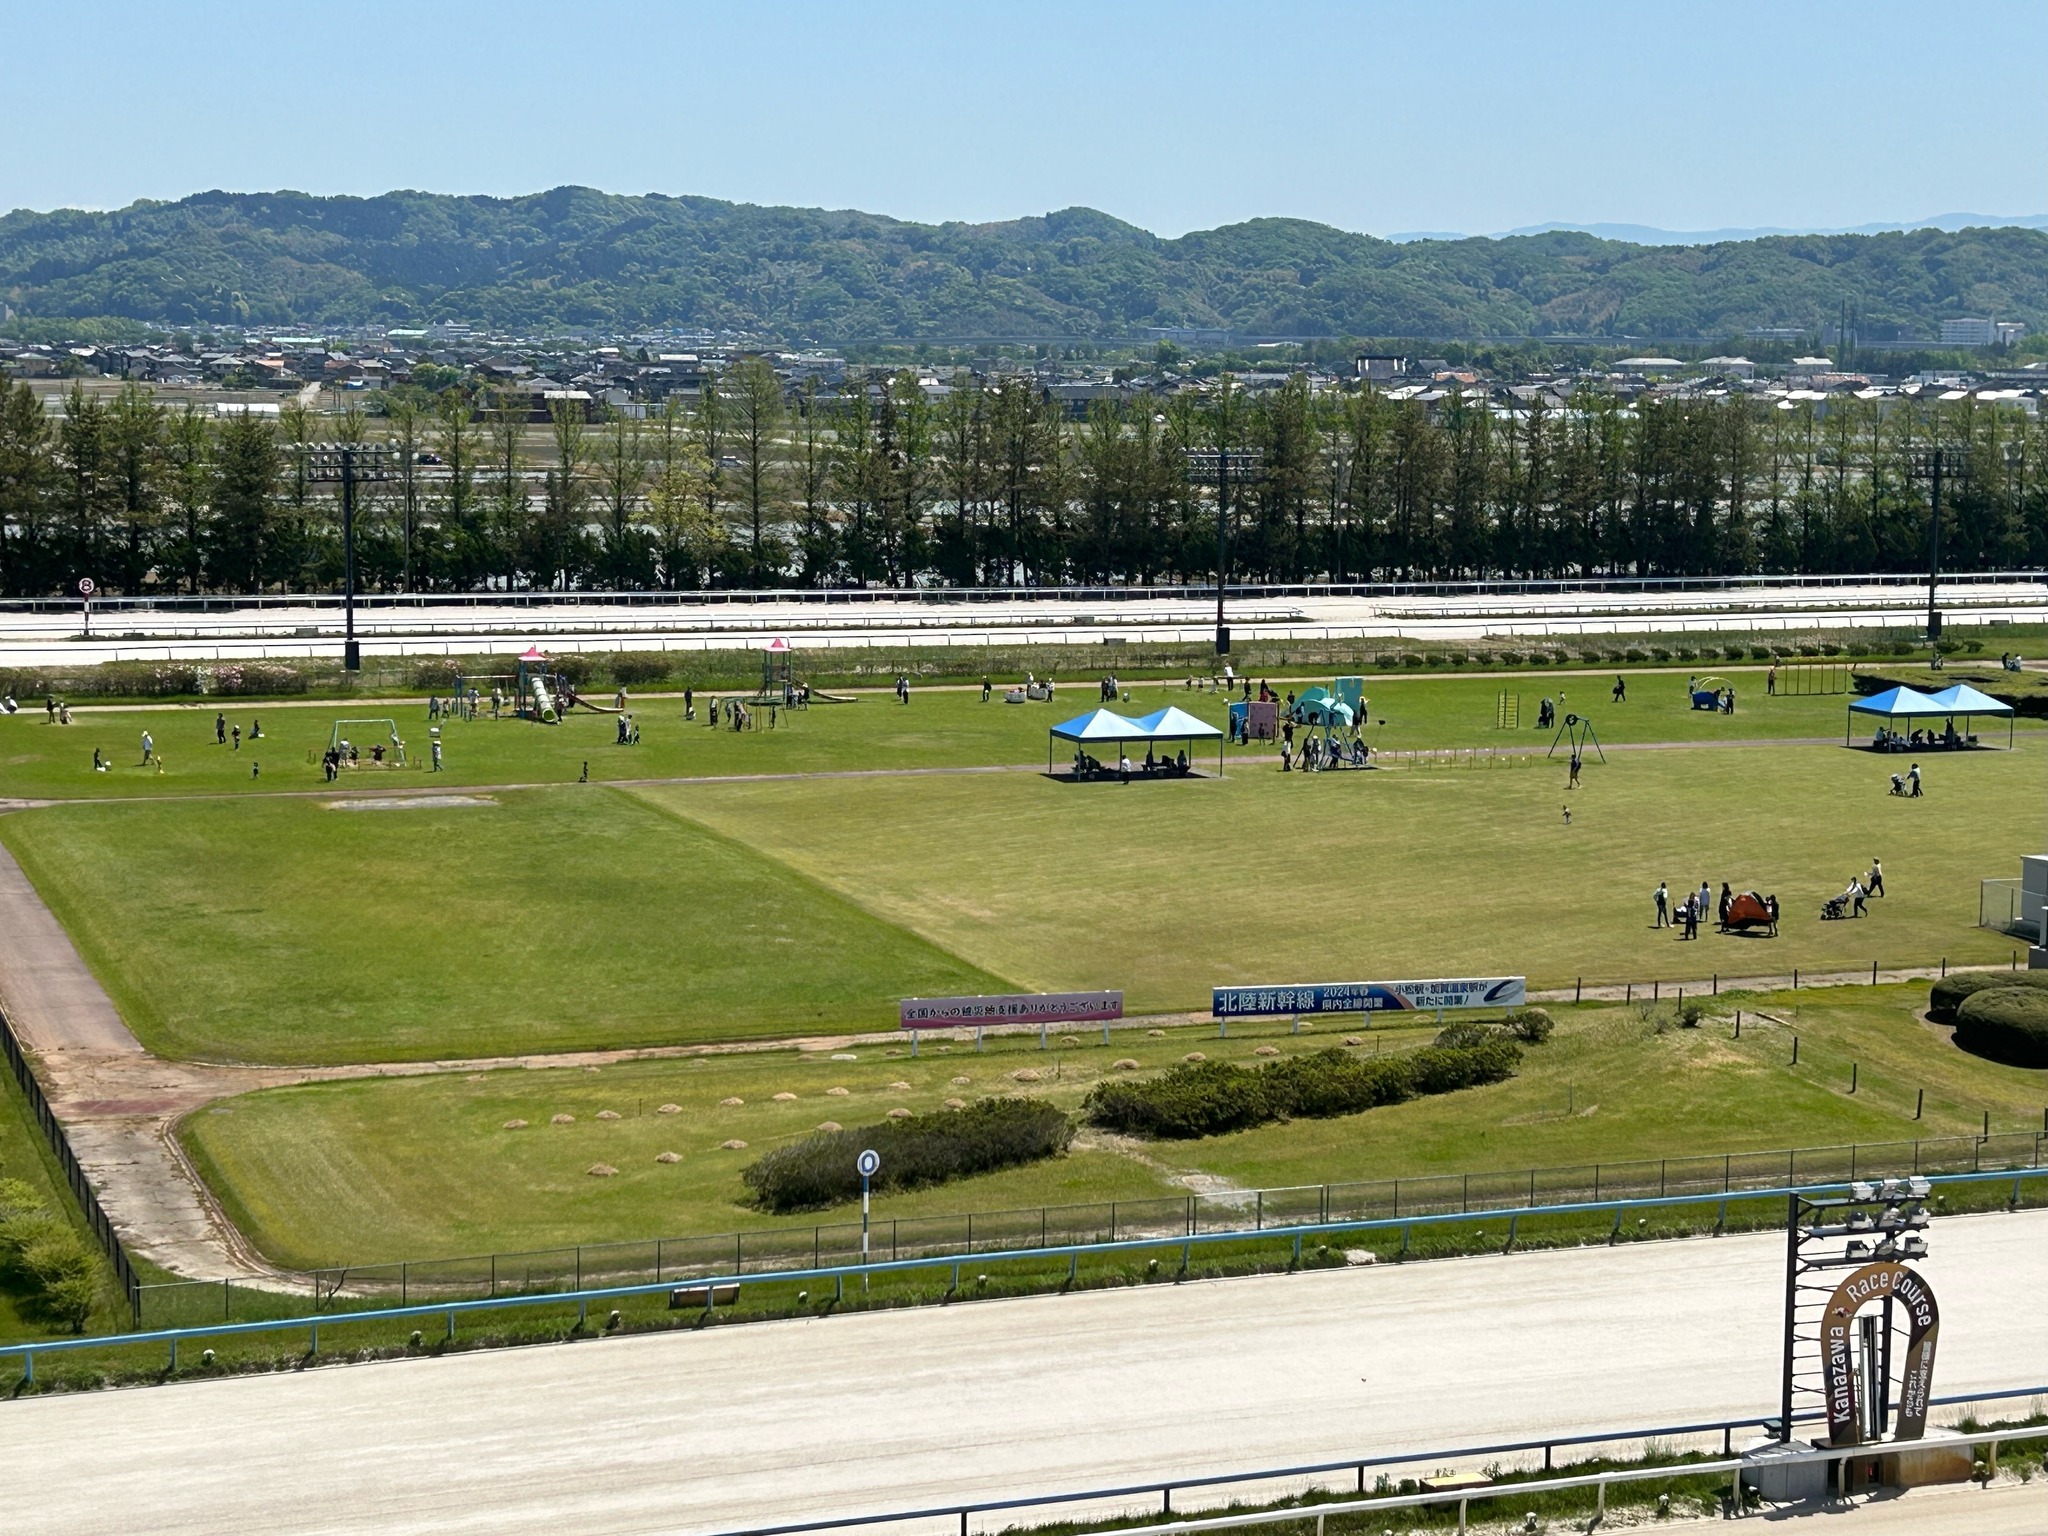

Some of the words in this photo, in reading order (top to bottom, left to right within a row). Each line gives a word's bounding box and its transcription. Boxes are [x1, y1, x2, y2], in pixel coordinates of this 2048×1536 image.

[1218, 990, 1315, 1013] 北陸新幹線
[1830, 1326, 1851, 1424] Kanazawa
[1846, 1271, 1889, 1303] Race
[1892, 1270, 1932, 1327] Course
